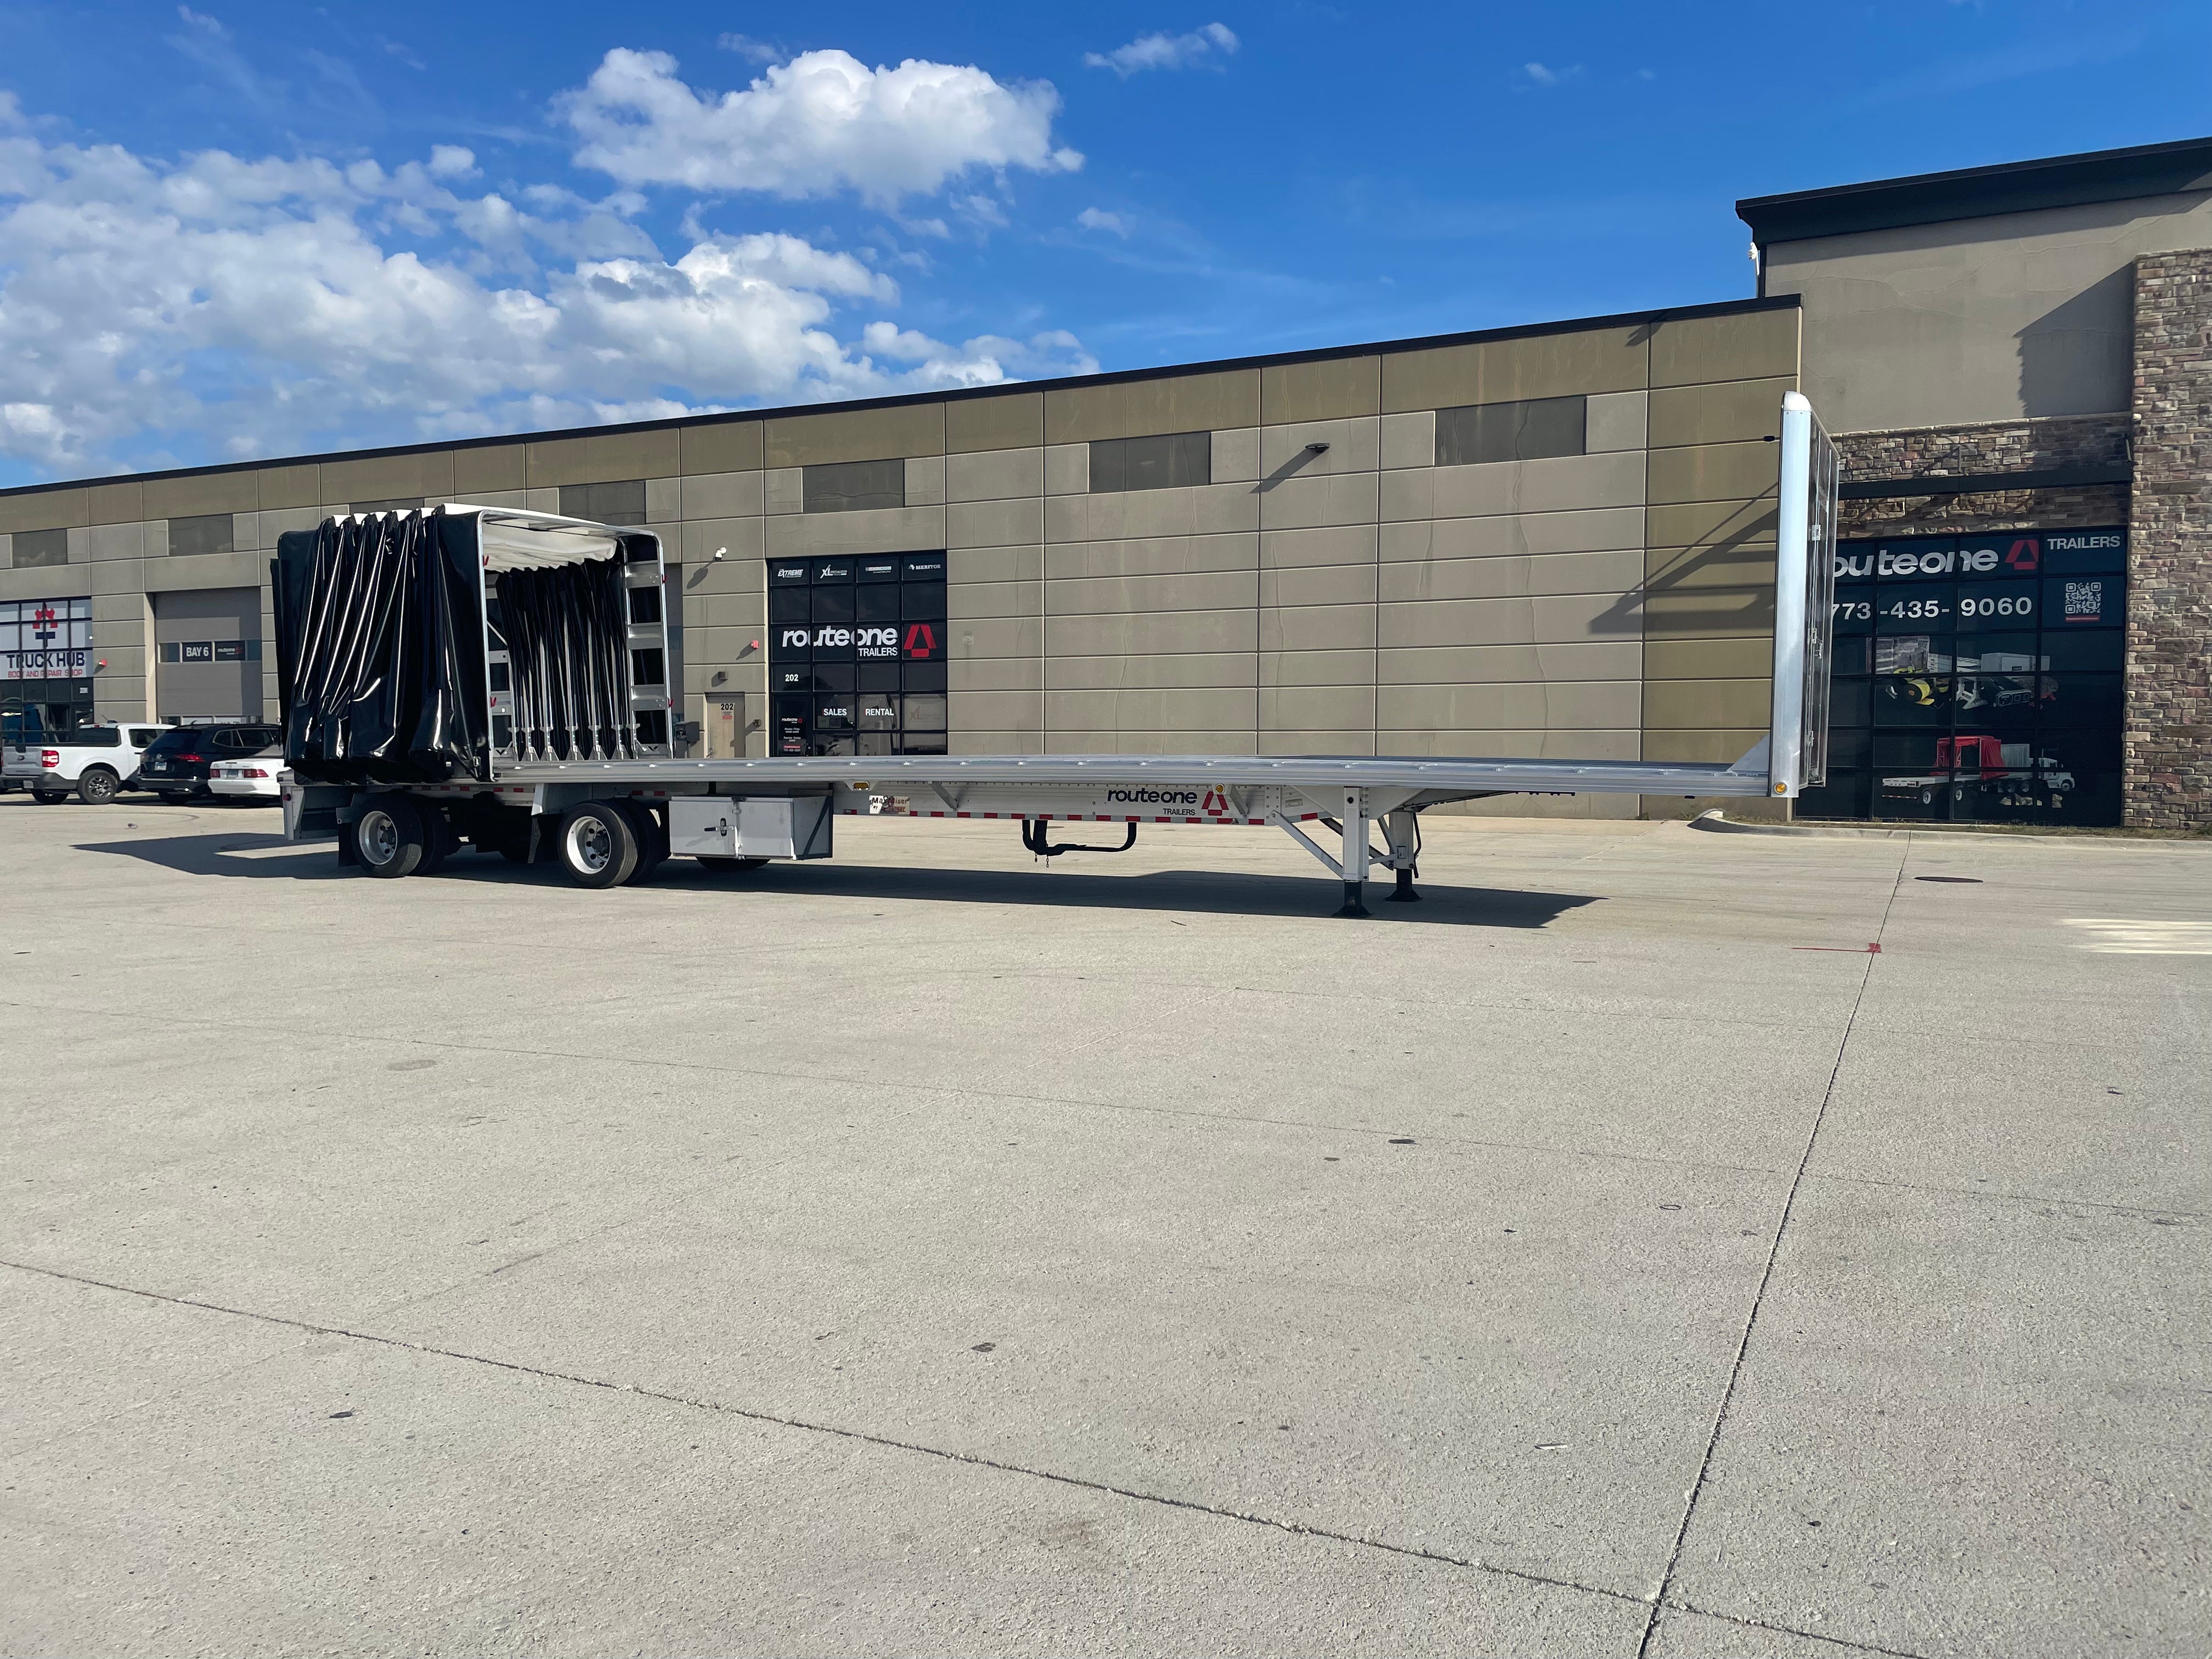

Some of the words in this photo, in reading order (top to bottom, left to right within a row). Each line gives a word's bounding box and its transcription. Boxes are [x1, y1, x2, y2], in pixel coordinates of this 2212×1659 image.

[2047, 535, 2121, 550] TRAILERS
[1833, 549, 1999, 578] outeone
[777, 568, 804, 578] EXTREME
[1961, 596, 2032, 616] 9060
[782, 625, 898, 647] routeone
[186, 646, 202, 657] BAY
[203, 646, 209, 657] 6
[858, 647, 898, 657] TRAILERS
[7, 652, 54, 668] TRUCK
[57, 652, 85, 667] HUB
[40, 669, 62, 678] RPAIR
[785, 674, 799, 682] 202
[823, 708, 848, 716] SALES
[865, 708, 894, 716] RENTAL
[1107, 787, 1198, 804] routeone
